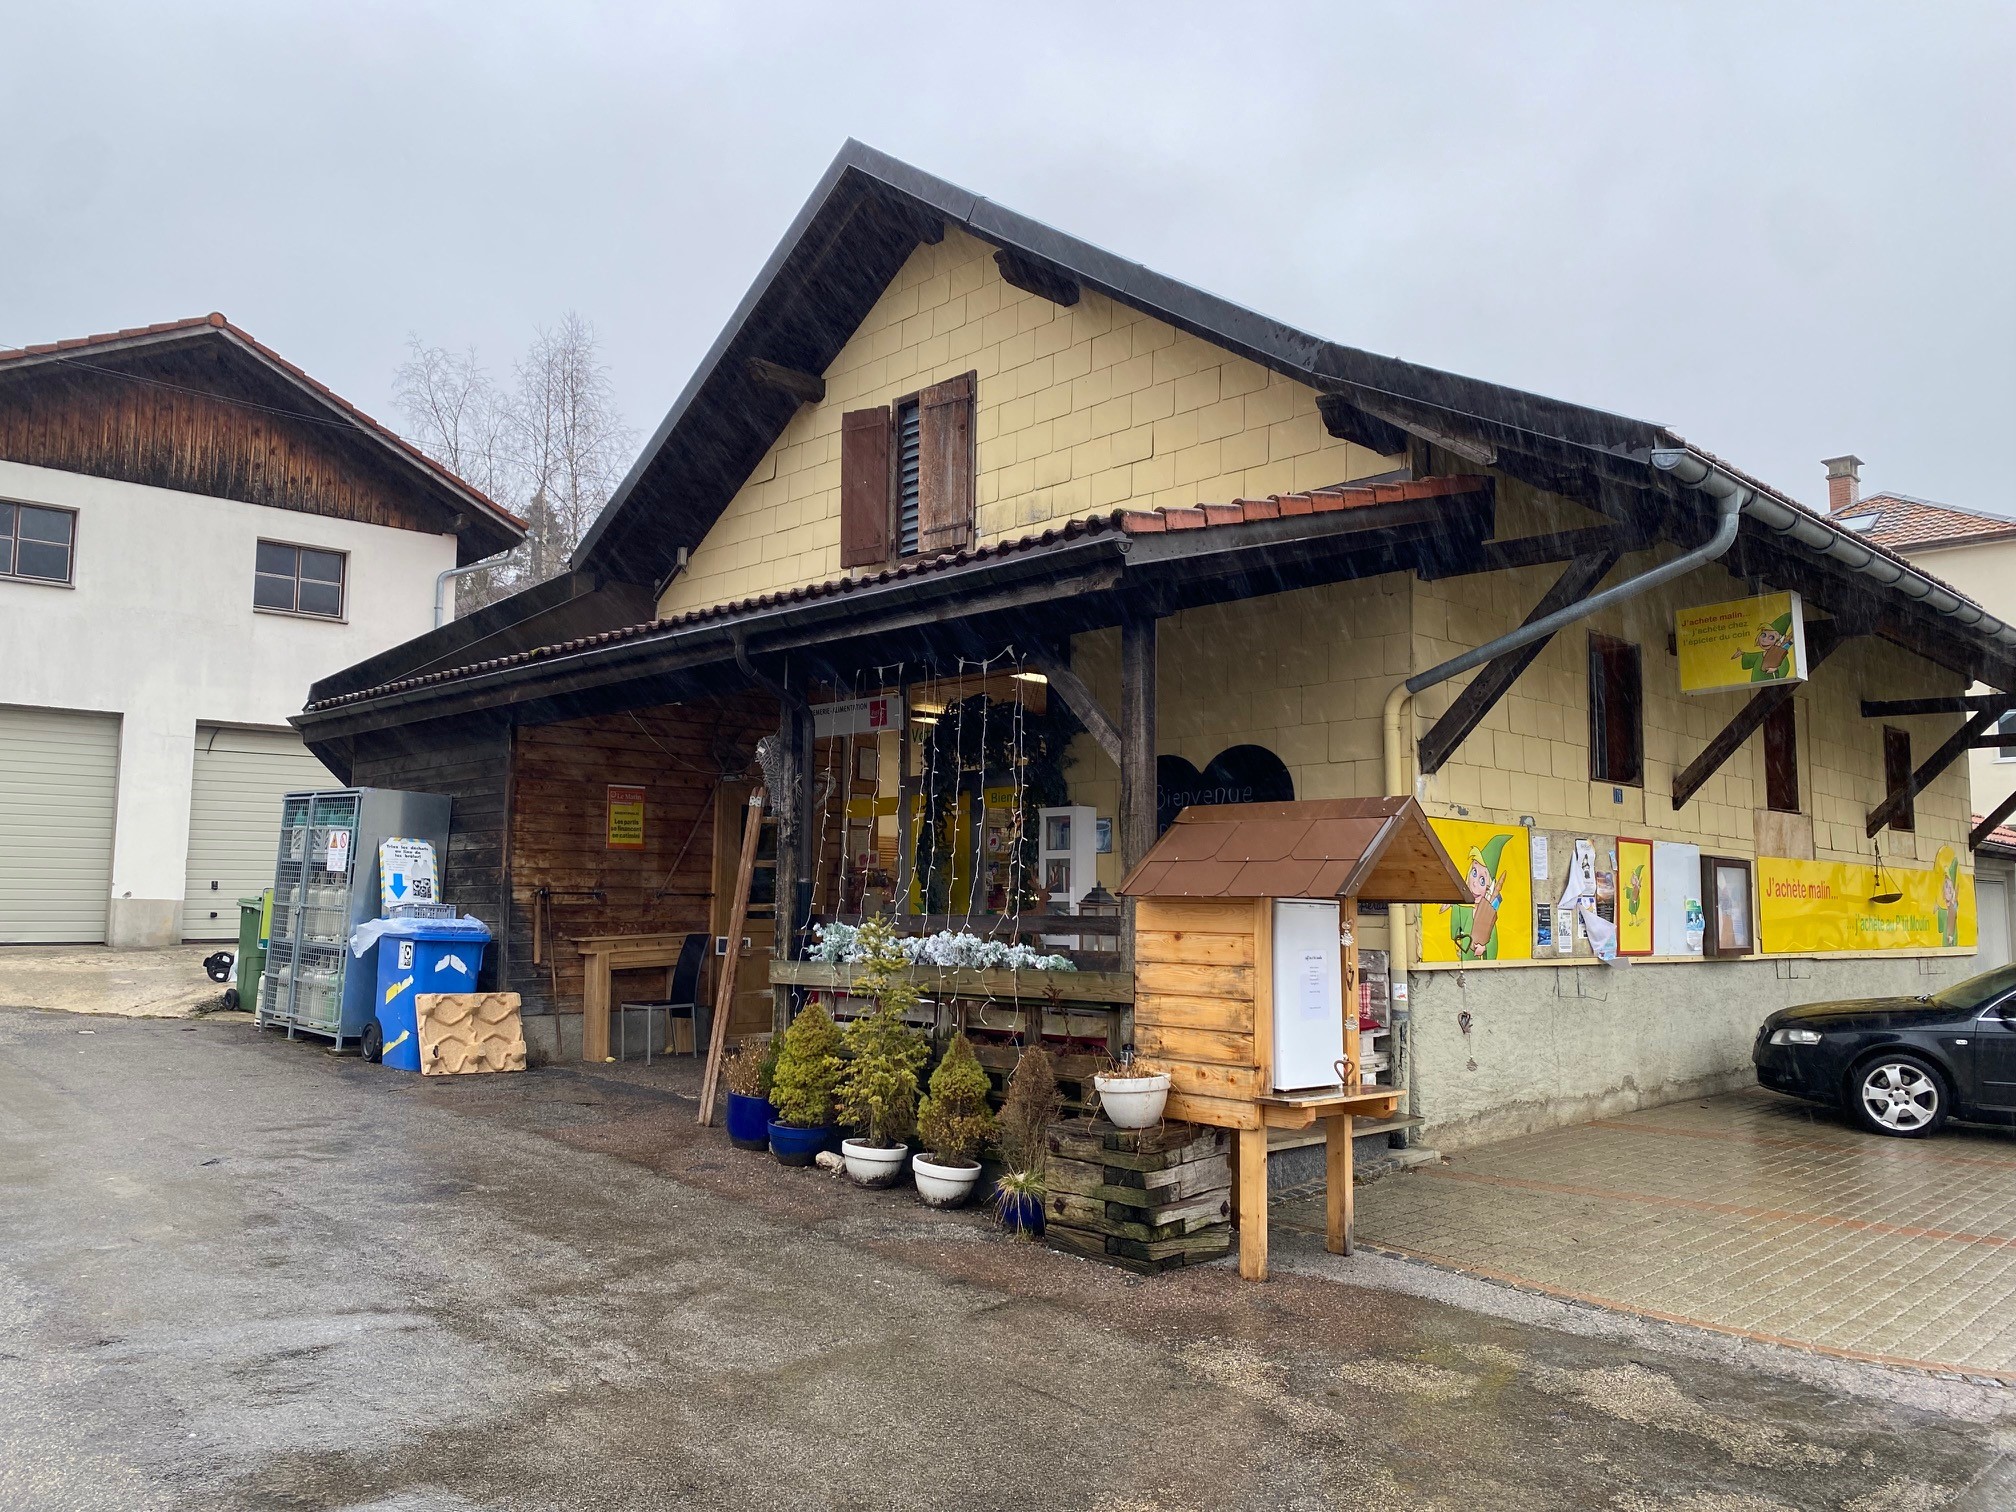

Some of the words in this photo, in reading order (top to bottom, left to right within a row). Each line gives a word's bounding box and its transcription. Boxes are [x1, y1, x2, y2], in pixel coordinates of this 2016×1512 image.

[1728, 621, 1749, 629] chez
[1732, 630, 1751, 639] coin
[1157, 785, 1254, 811] Bienvenue
[1766, 877, 1807, 898] J'achète
[1808, 880, 1839, 900] malin...
